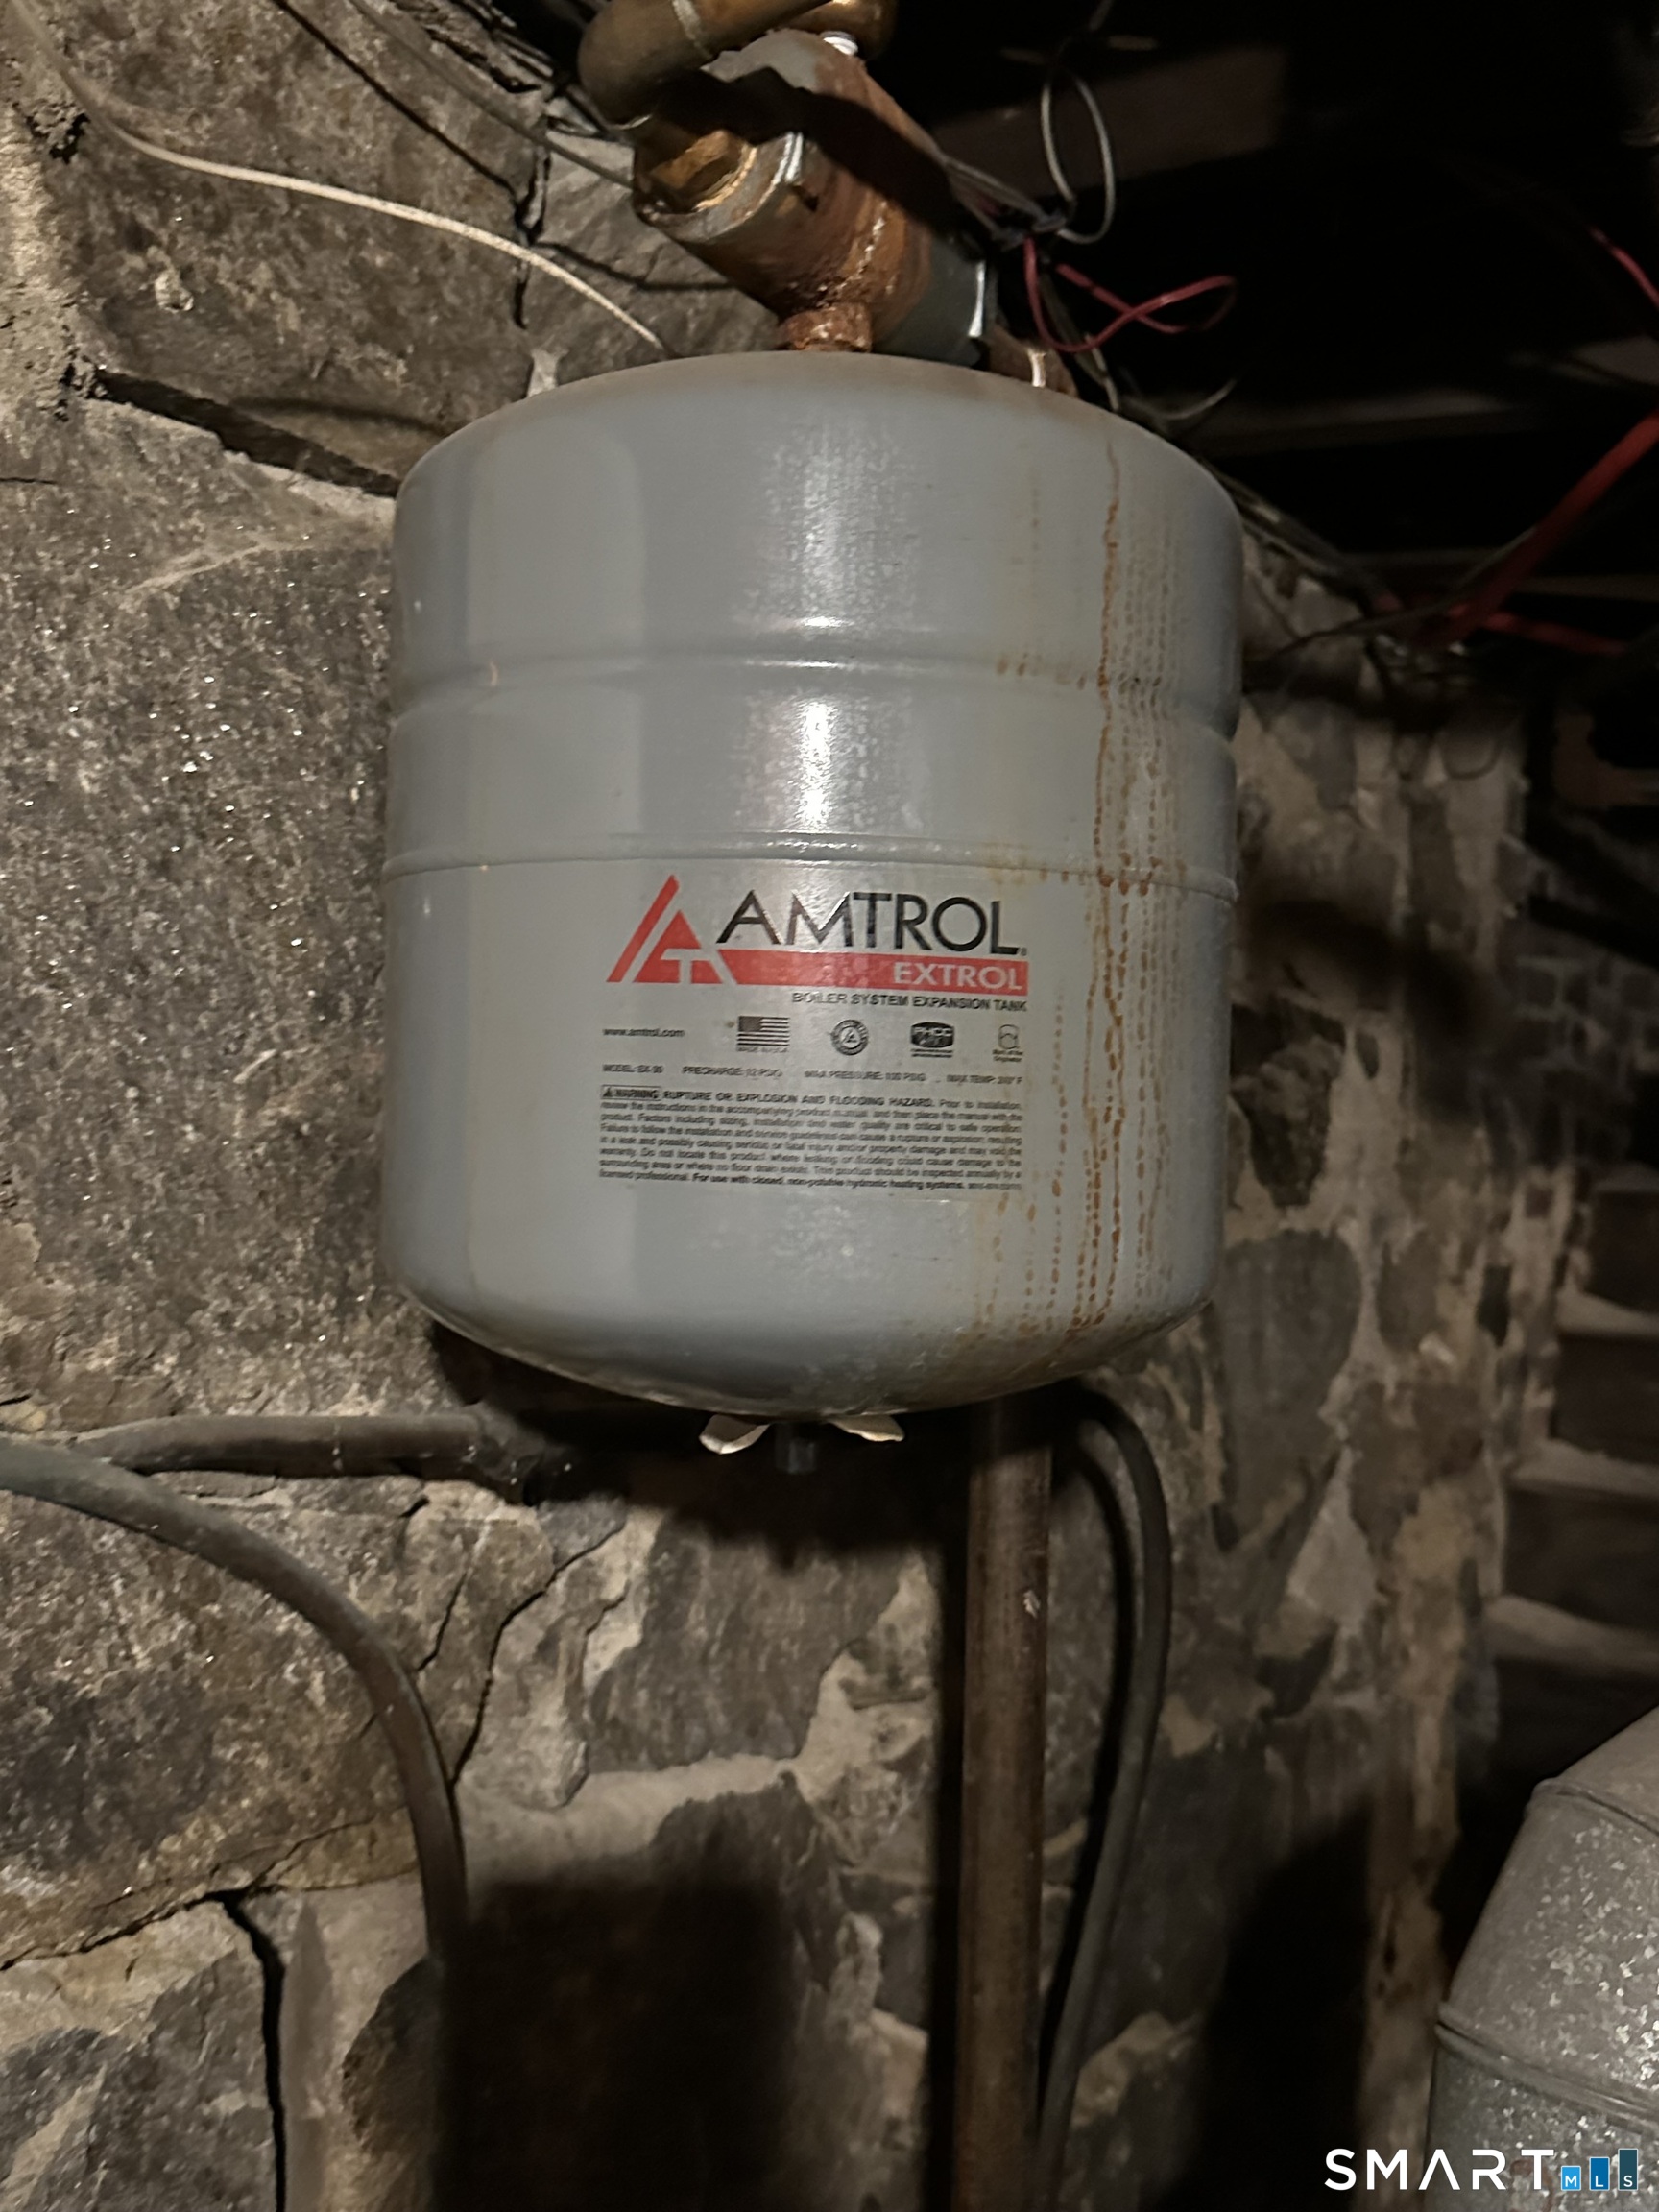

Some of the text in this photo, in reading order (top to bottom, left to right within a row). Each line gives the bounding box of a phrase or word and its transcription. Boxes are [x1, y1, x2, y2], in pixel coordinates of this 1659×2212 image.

[716, 890, 1020, 955] AMTROL
[894, 961, 1022, 990] EXTROL
[793, 992, 1027, 1012] BOILER SYSTEM EXPANSION TANK
[662, 1091, 712, 1100] RUPTURE
[715, 1092, 733, 1101] OR
[736, 1093, 798, 1103] EXPLOSION
[801, 1095, 826, 1104] AND
[830, 1095, 885, 1105] FLOODING
